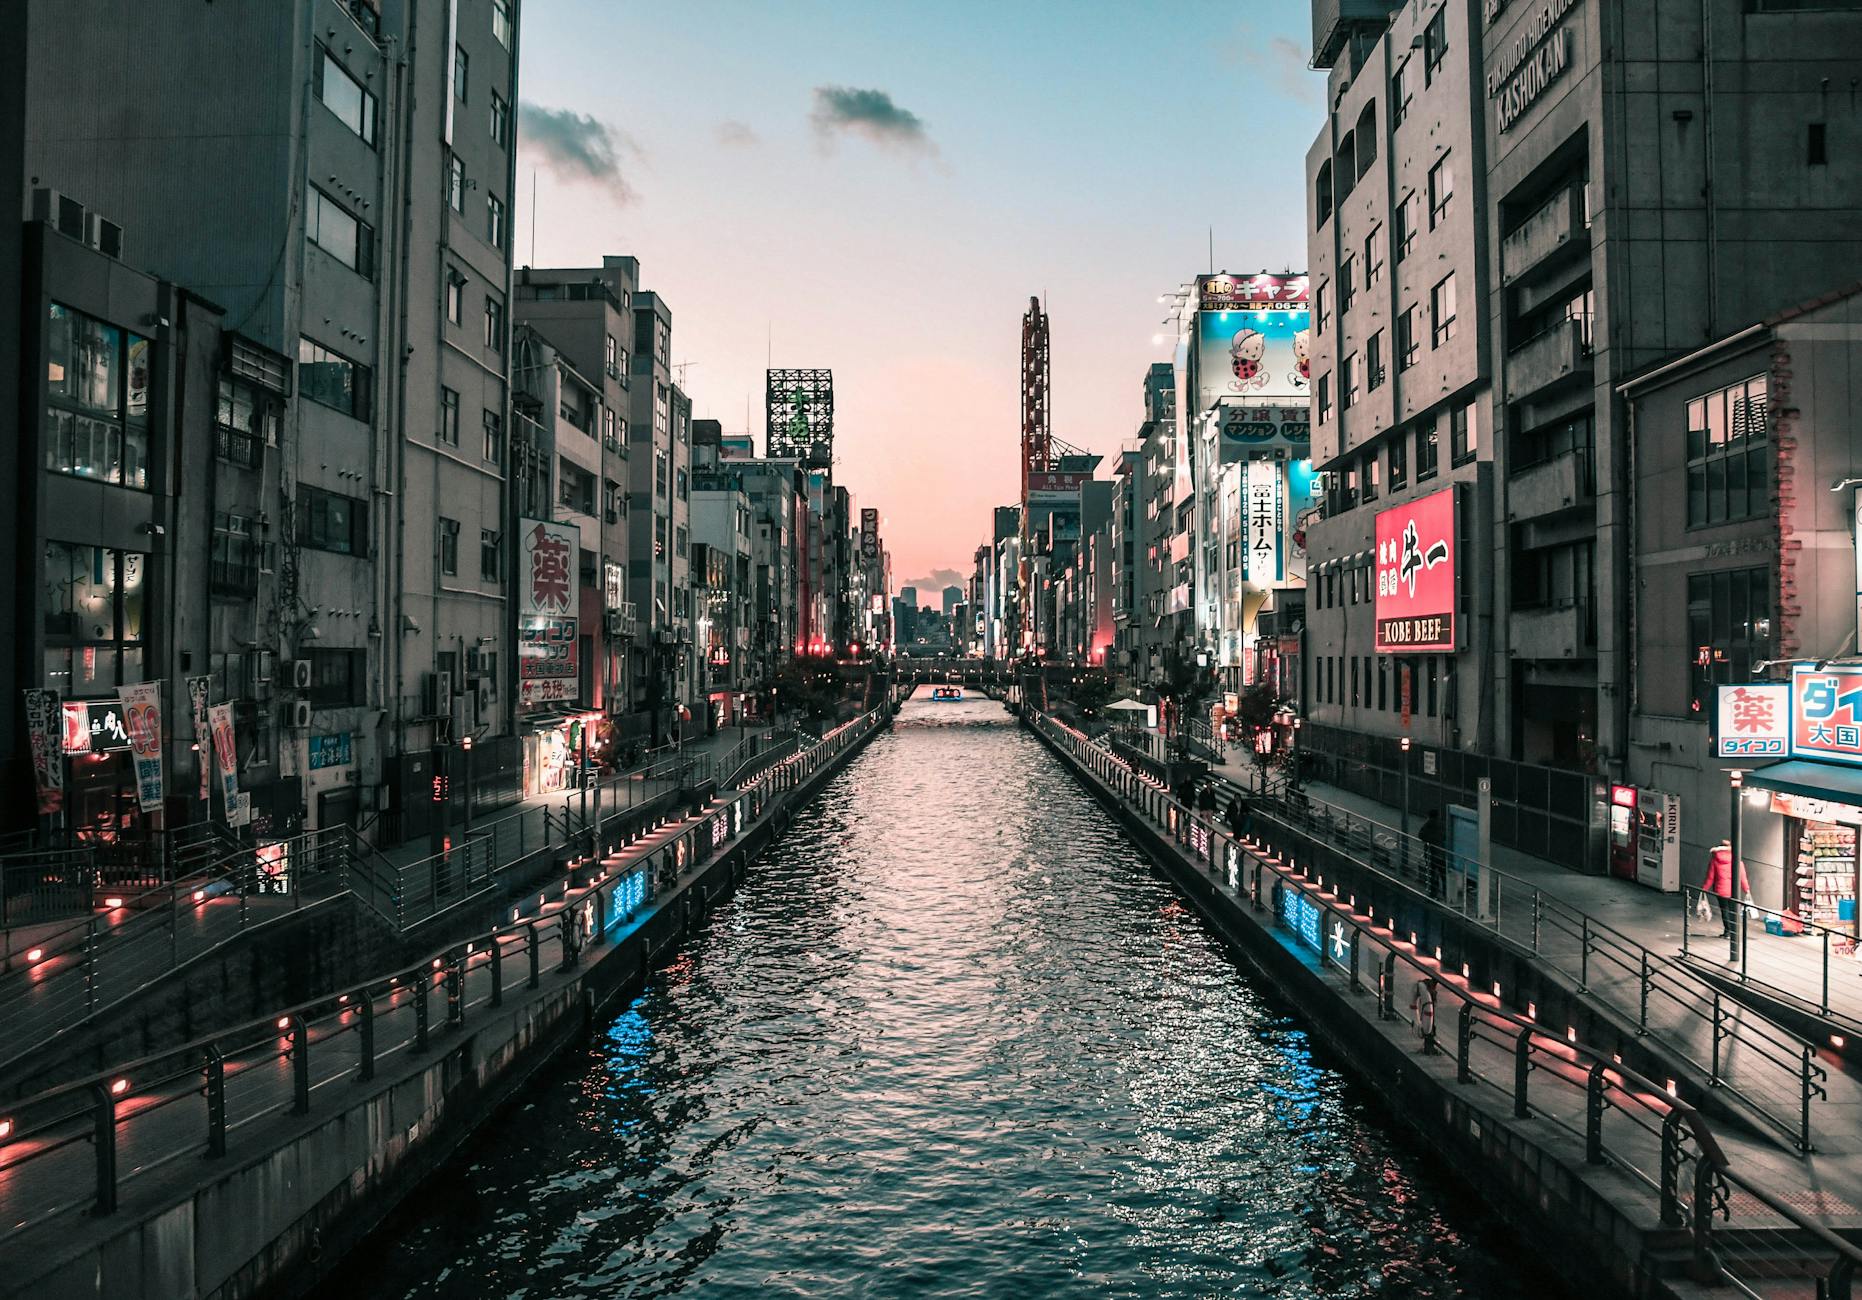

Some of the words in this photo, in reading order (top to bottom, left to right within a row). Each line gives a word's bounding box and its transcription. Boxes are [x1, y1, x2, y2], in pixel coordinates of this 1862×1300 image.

[1487, 33, 1527, 98] FUKUJUDO
[1496, 28, 1565, 134] KASHOKAN
[1235, 280, 1309, 300] キャラ
[1228, 424, 1275, 435] マンション
[531, 527, 571, 613] 薬
[1384, 621, 1412, 643] KOBE
[1414, 618, 1442, 641] BEEF
[1733, 689, 1775, 734] 薬
[1668, 804, 1677, 834] KIRIN
